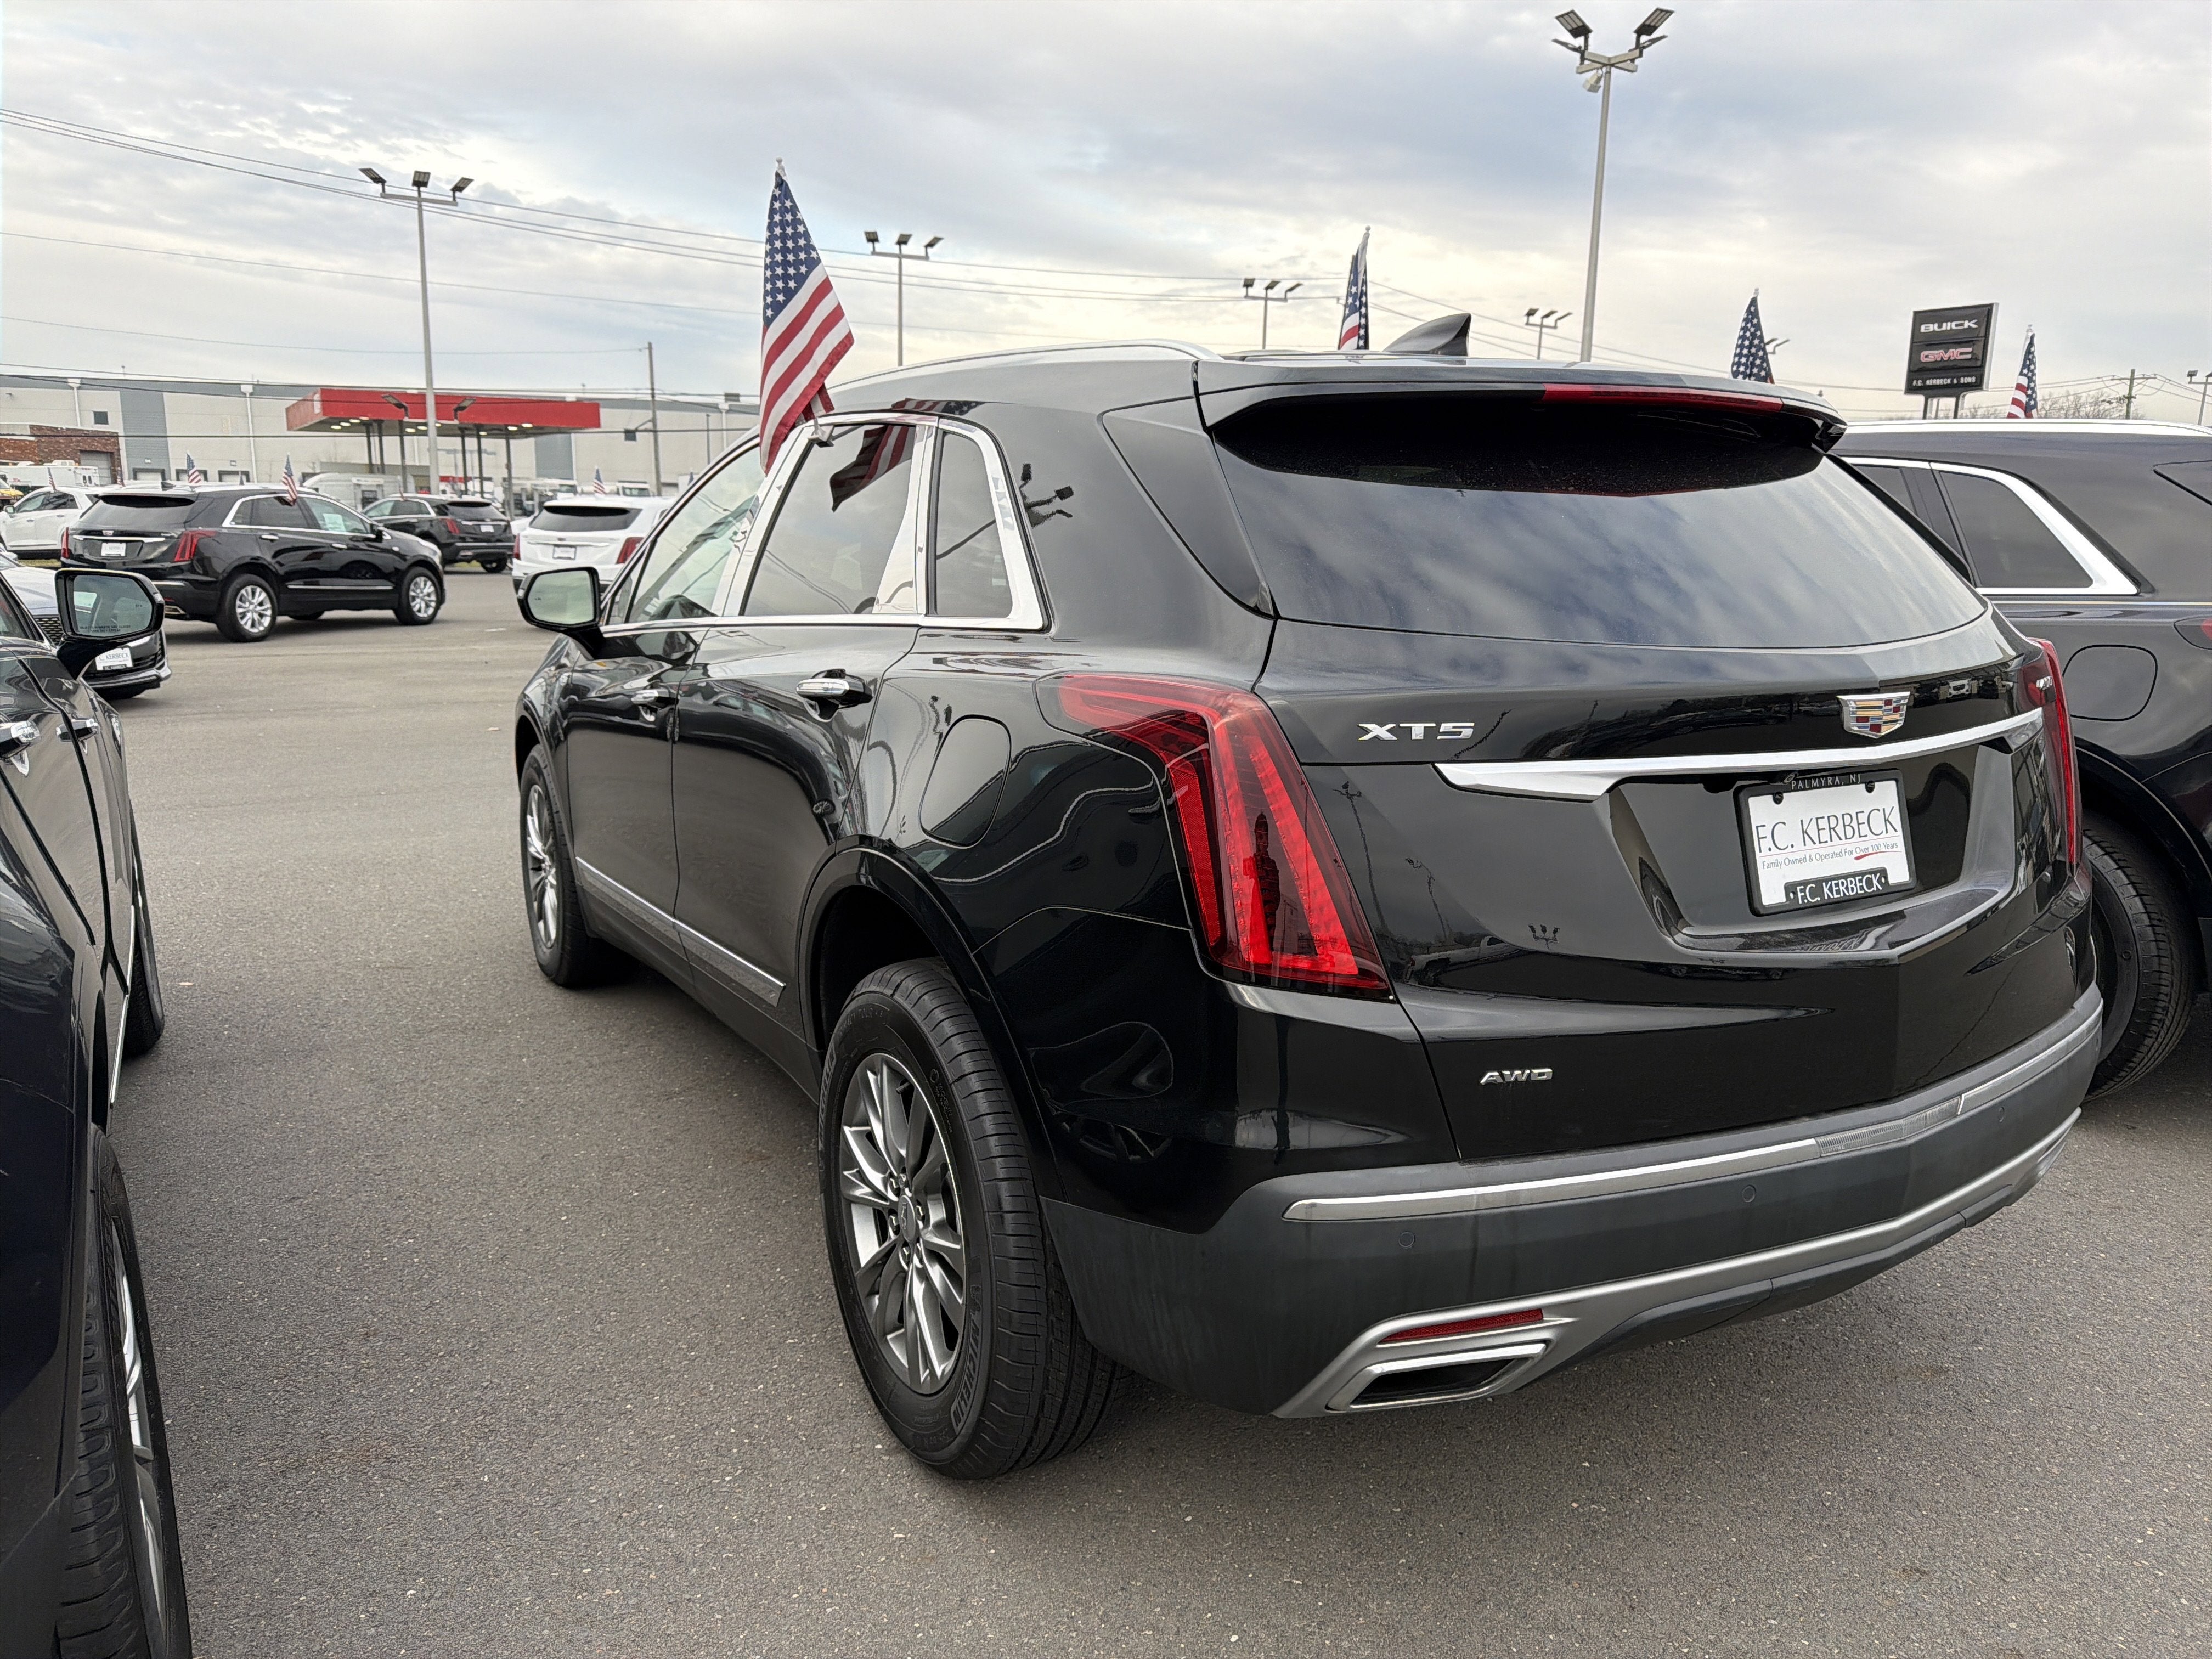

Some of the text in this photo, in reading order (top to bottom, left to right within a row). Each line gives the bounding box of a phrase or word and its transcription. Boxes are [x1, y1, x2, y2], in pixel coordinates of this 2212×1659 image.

[1921, 319, 1978, 332] BUICK
[1921, 347, 1973, 362] GMC
[1357, 723, 1475, 740] XT5
[1791, 774, 1860, 790] PALMYRA, NJ
[1756, 806, 1898, 853] F.C. KERBECK
[1762, 860, 1782, 870] Family
[1784, 854, 1807, 866] Owned
[1815, 849, 1843, 862] Operated
[1844, 848, 1854, 857] For
[1855, 845, 1870, 854] Over
[1871, 843, 1882, 851] 100
[1883, 842, 1898, 850] Years
[1797, 873, 1883, 904] F.C. KERBECK
[1480, 1069, 1553, 1085] AWD
[953, 1317, 979, 1427] MICHELIN
